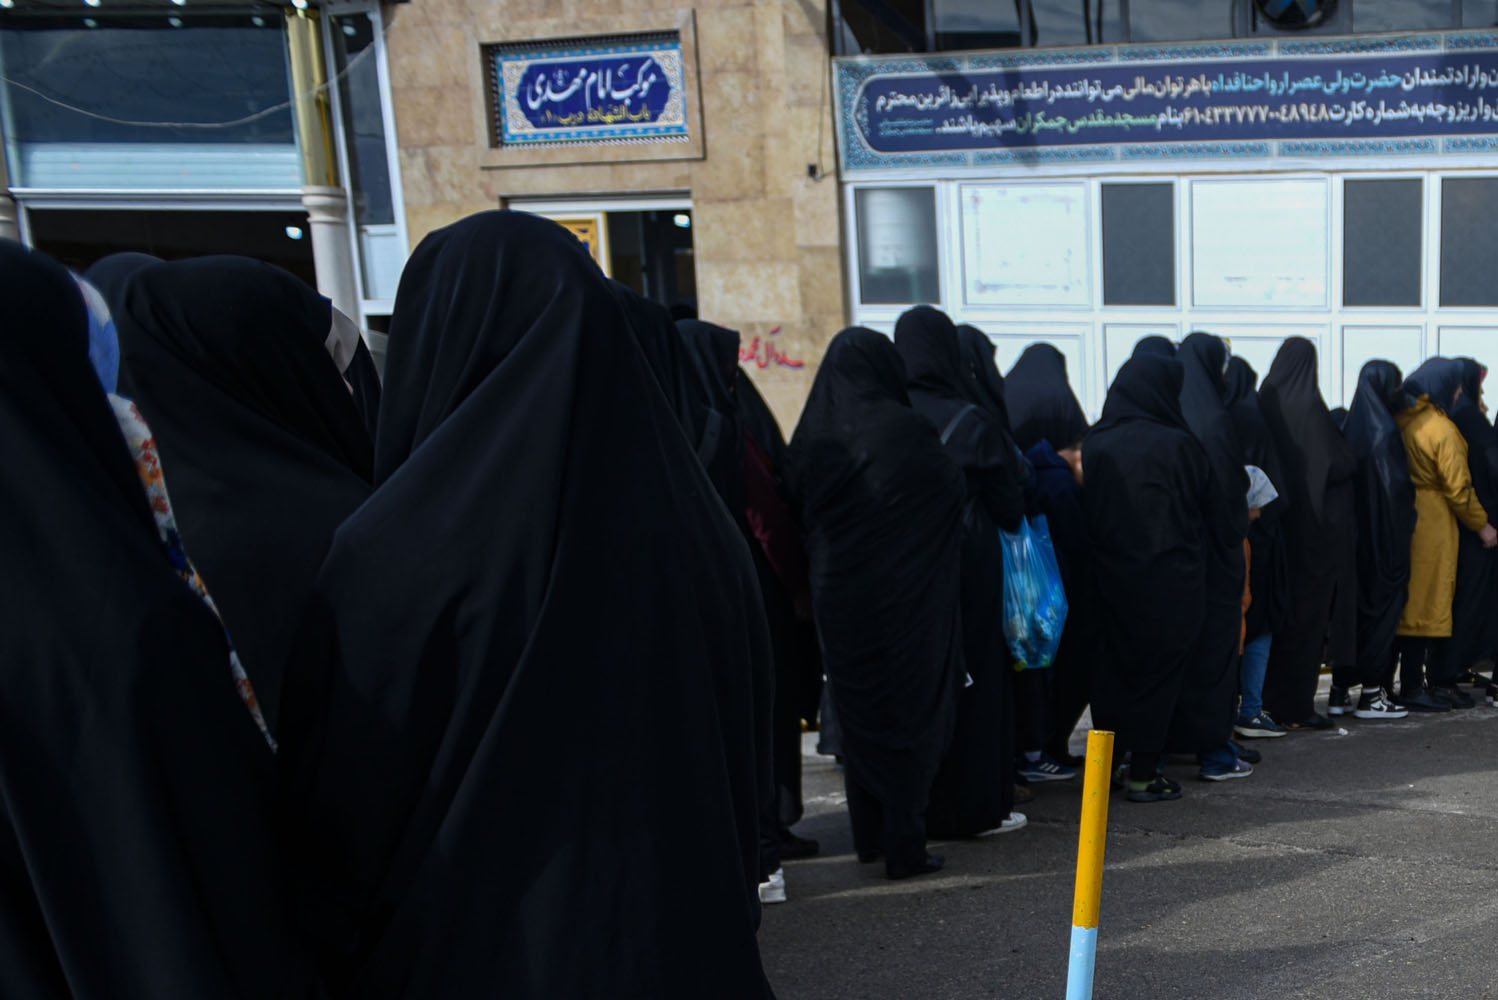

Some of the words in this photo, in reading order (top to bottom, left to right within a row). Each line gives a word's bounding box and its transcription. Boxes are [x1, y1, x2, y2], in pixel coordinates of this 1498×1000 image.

[586, 68, 612, 113] امام
[1350, 68, 1402, 95] حضرت
[876, 91, 917, 113] محترم
[1329, 100, 1367, 127] کارت
[1365, 100, 1411, 126] شماره
[1016, 110, 1068, 135] جمکران
[1067, 108, 1114, 134] مقدس
[1114, 111, 1157, 132] مسجد
